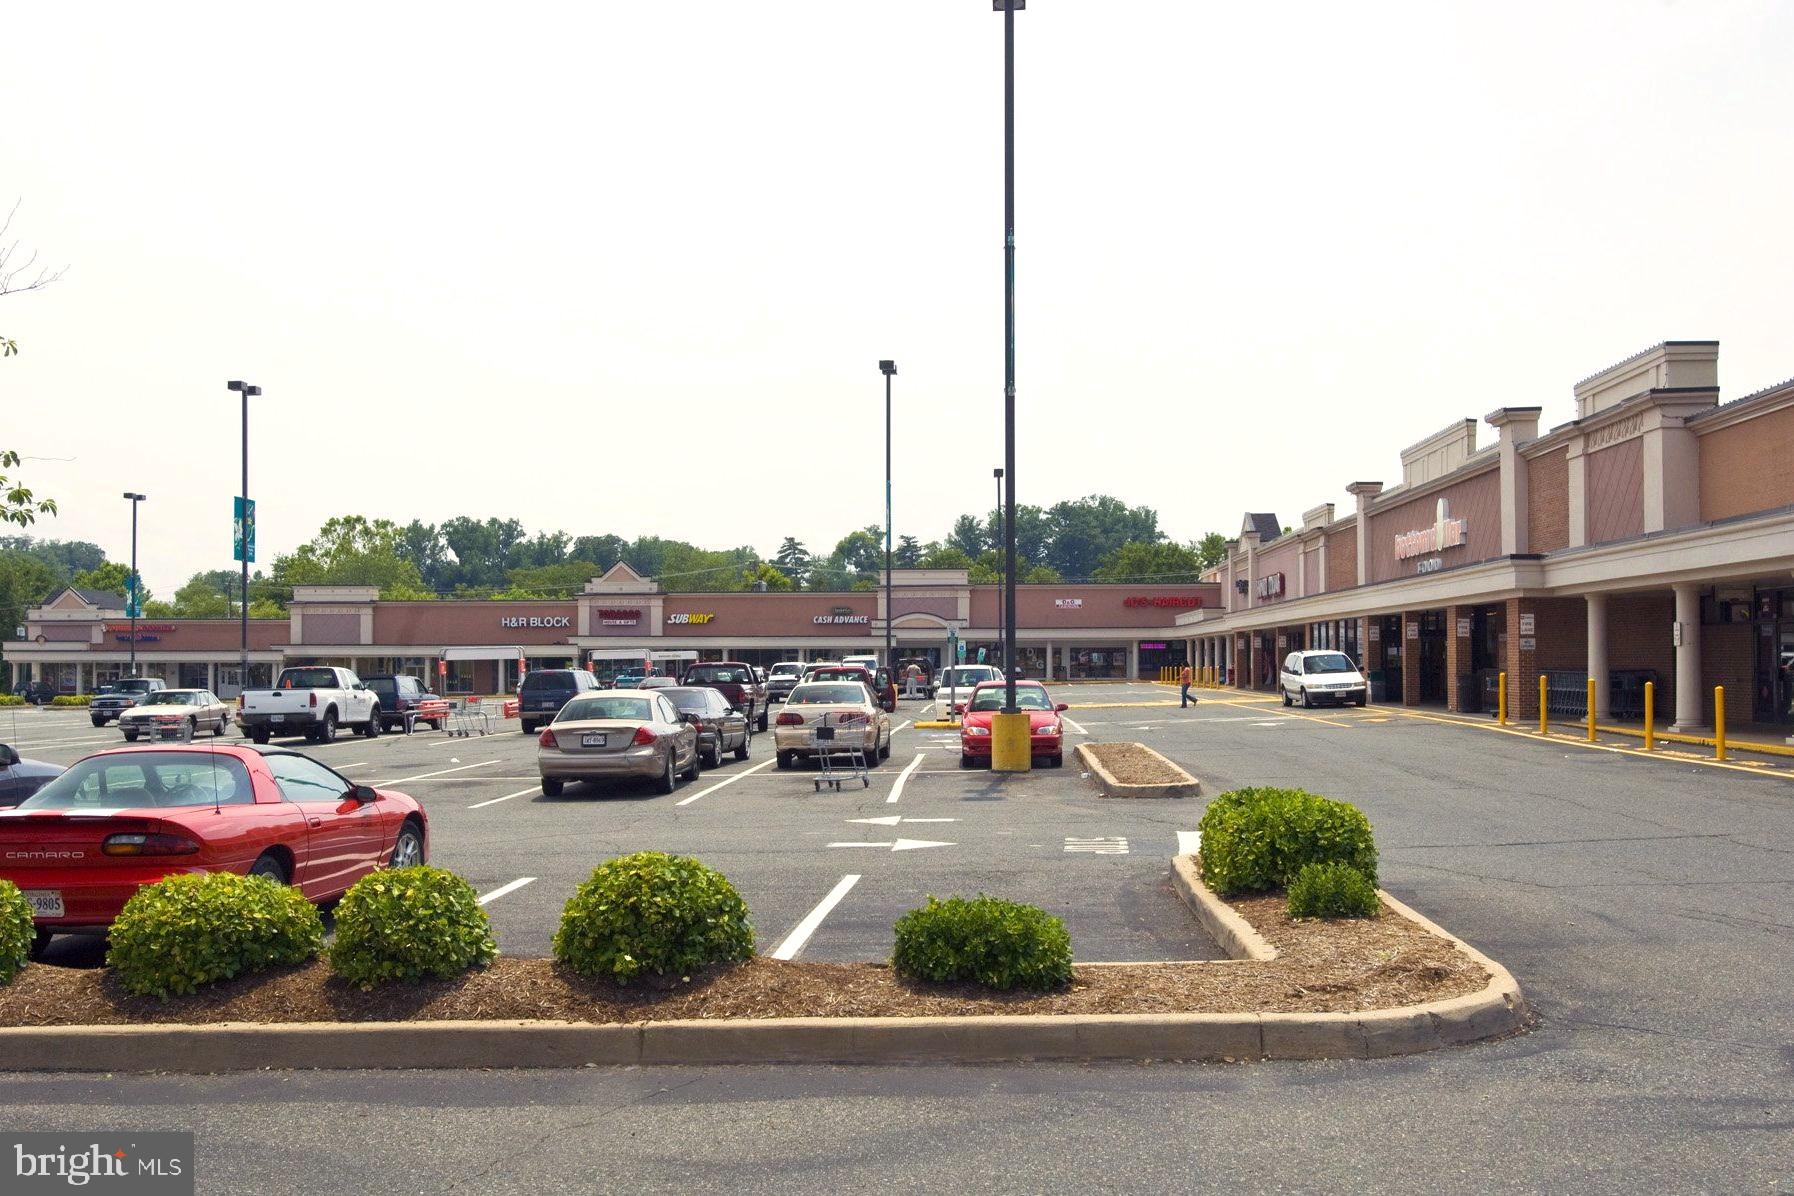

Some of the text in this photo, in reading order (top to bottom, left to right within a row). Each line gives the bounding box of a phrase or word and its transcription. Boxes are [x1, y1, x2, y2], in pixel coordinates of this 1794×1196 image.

[1417, 559, 1442, 573] FOOD
[501, 616, 570, 627] H&R BLOCK
[667, 613, 714, 625] SUBWAY
[813, 615, 869, 624] CASH ADVANCE
[5, 851, 85, 859] CAMARO
